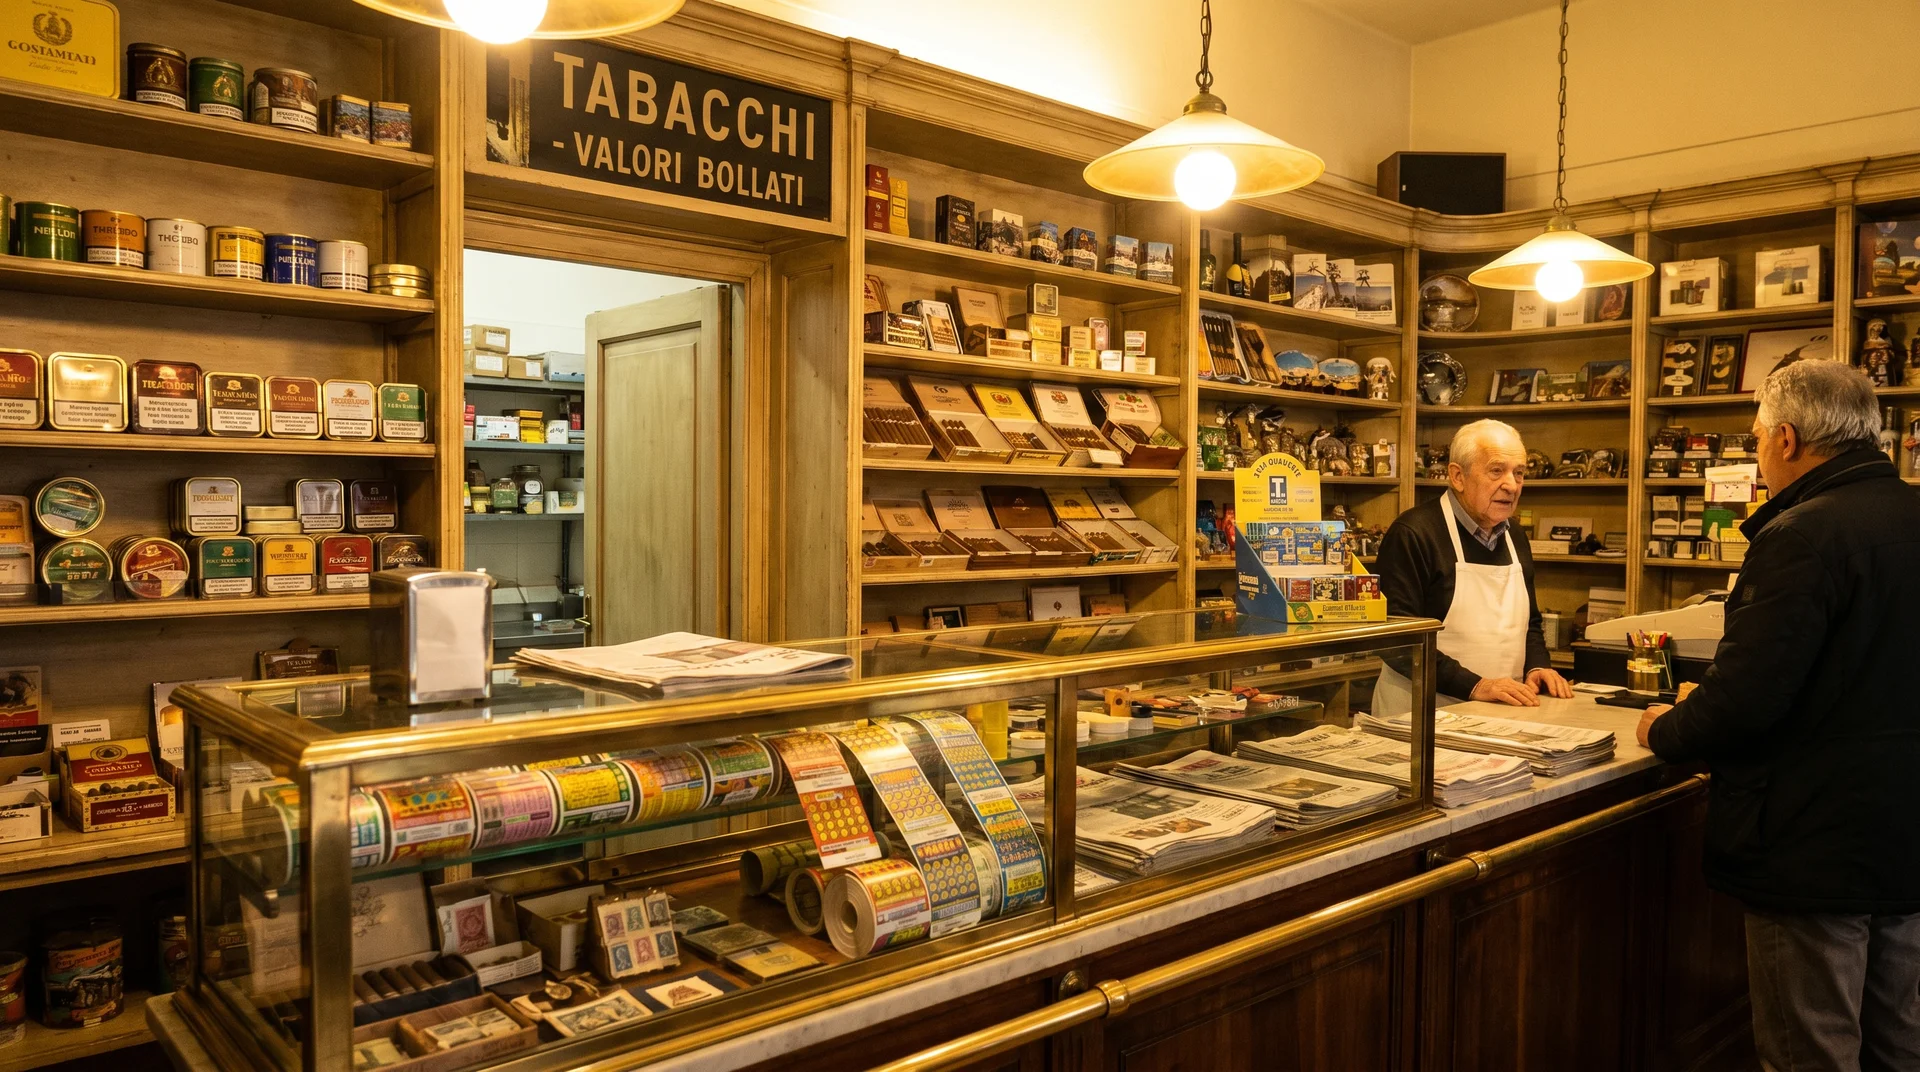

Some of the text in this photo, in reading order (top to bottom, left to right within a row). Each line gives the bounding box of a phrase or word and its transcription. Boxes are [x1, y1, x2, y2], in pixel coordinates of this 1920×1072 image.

[553, 51, 815, 161] TABACCHI
[573, 131, 682, 184] VALORI
[698, 155, 803, 207] BOLLATI
